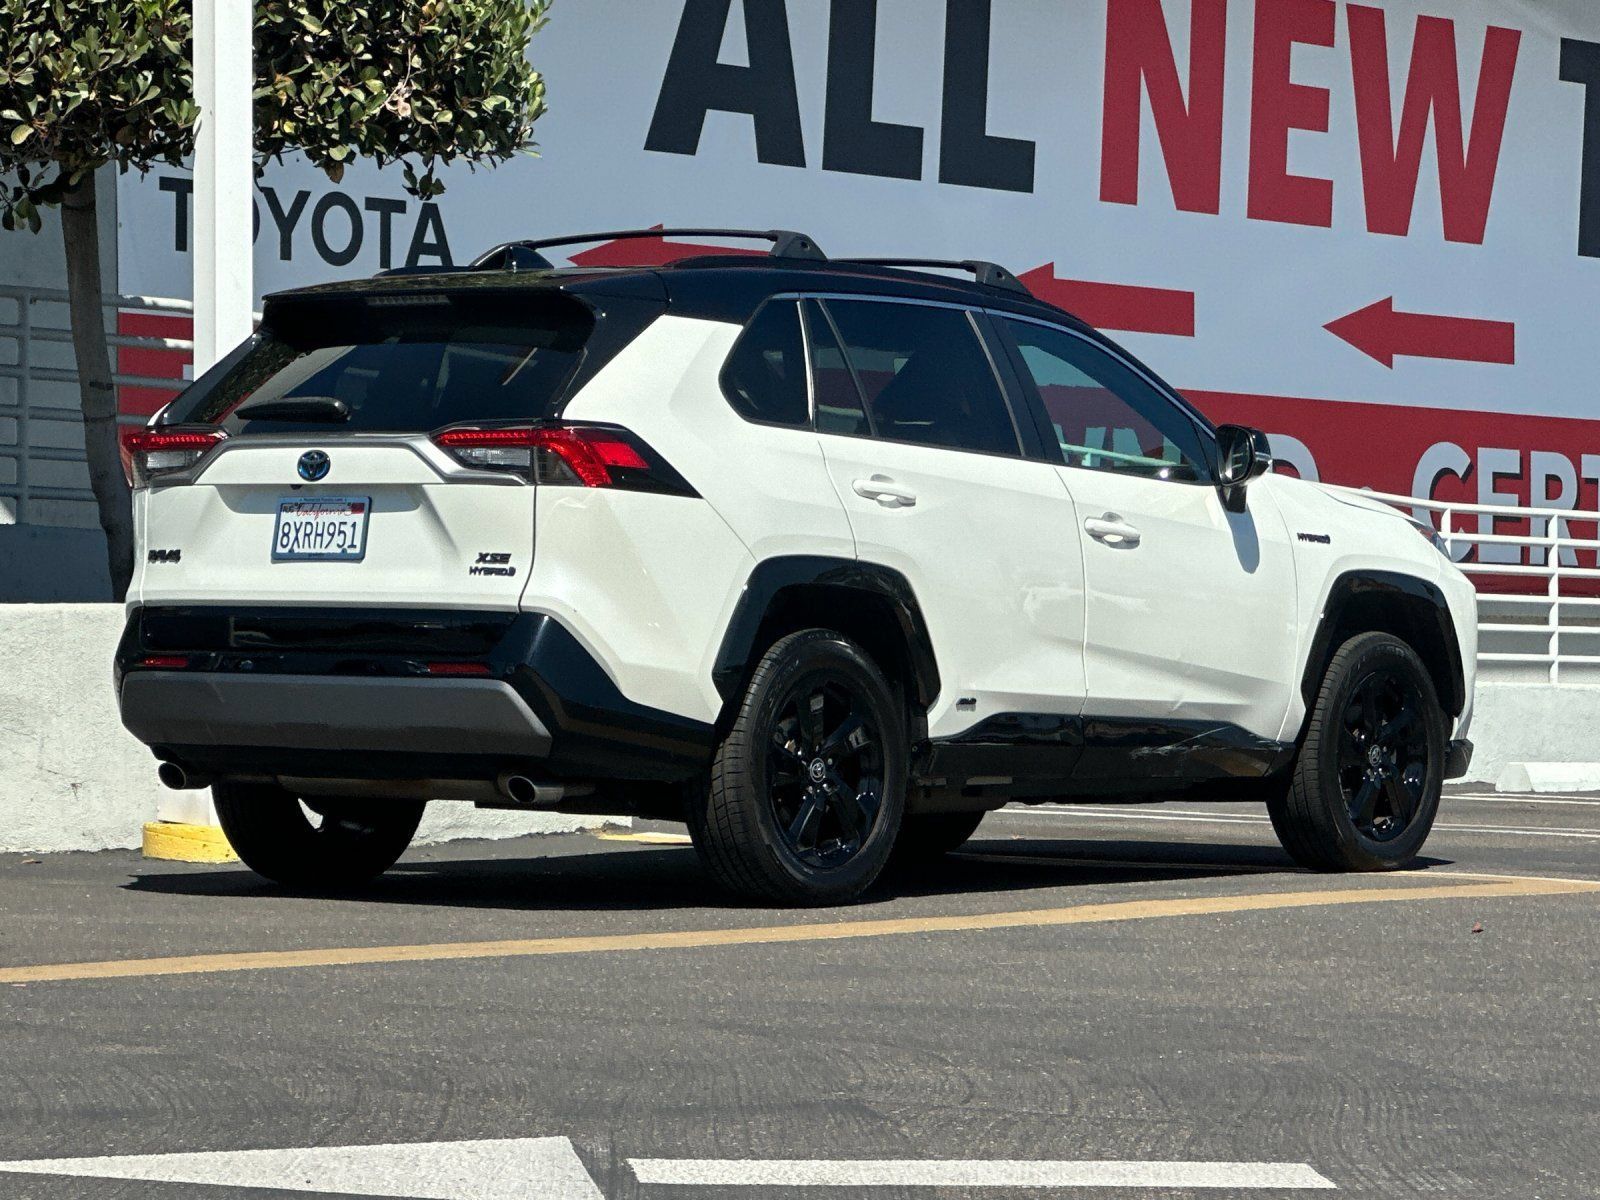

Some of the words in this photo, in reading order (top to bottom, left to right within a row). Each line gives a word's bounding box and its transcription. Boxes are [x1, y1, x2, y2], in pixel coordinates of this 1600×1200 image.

[643, 0, 1036, 194] ALL
[1099, 0, 1522, 245] NEW
[158, 175, 454, 269] TYOTA
[279, 520, 358, 550] 8XRH951
